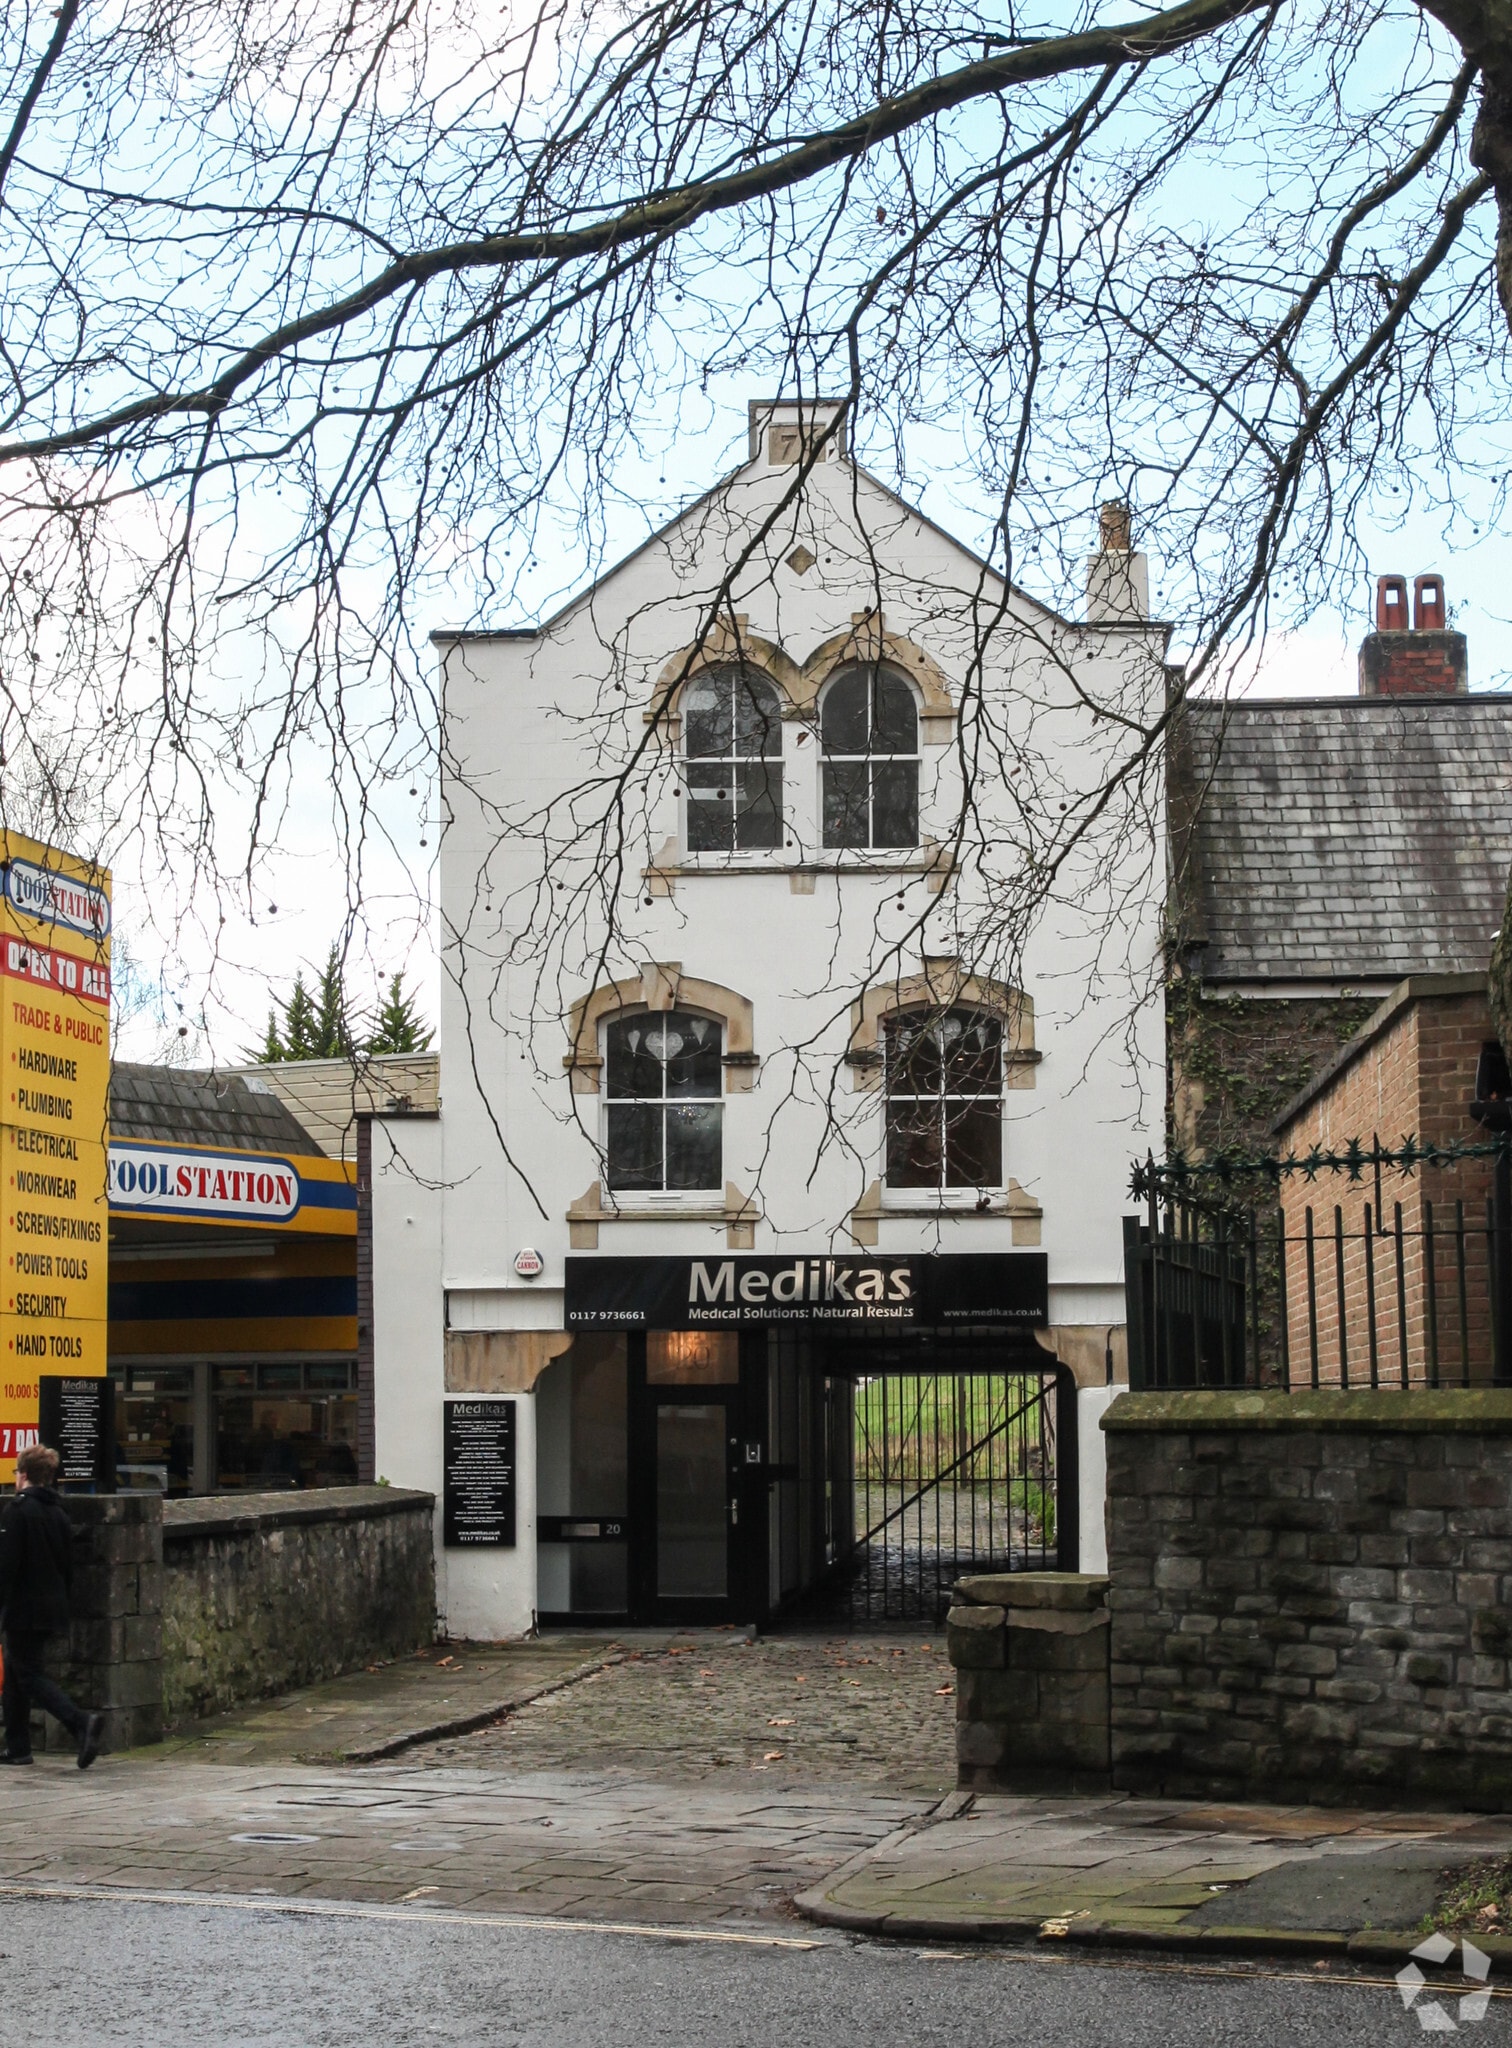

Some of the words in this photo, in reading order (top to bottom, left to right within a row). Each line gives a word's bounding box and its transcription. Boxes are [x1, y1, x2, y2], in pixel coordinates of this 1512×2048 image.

[8, 941, 51, 981] OPEN
[57, 957, 77, 989] TO
[82, 966, 108, 998] ALL
[13, 1002, 50, 1031] TRADE
[54, 1014, 62, 1035] &
[66, 1017, 102, 1045] PUBLIC
[19, 1048, 77, 1081] HARDWARE
[18, 1088, 72, 1120] PLUMBING
[17, 1129, 78, 1161] ELECTRICAL
[17, 1170, 76, 1200] WORKWEAR
[17, 1211, 101, 1242] SCREWS/FIXINGS
[16, 1252, 52, 1277] POWER
[55, 1256, 87, 1280] TOOLS
[688, 1260, 911, 1303] Medikas
[16, 1293, 67, 1317] SECURITY
[569, 1311, 597, 1320] 0117
[599, 1311, 646, 1320] 9736661
[688, 1308, 740, 1319] Medical
[743, 1307, 809, 1319] Solutions:
[812, 1306, 863, 1318] Natural
[867, 1306, 914, 1318] Results
[943, 1308, 1042, 1317] www.medikas.co.uk
[16, 1334, 46, 1357] HAND
[50, 1336, 82, 1358] TOOLS
[4, 1384, 31, 1399] 10,000
[61, 1380, 98, 1391] Medikas
[453, 1403, 506, 1414] Medikas
[3, 1429, 11, 1453] 7
[606, 1524, 621, 1534] 20
